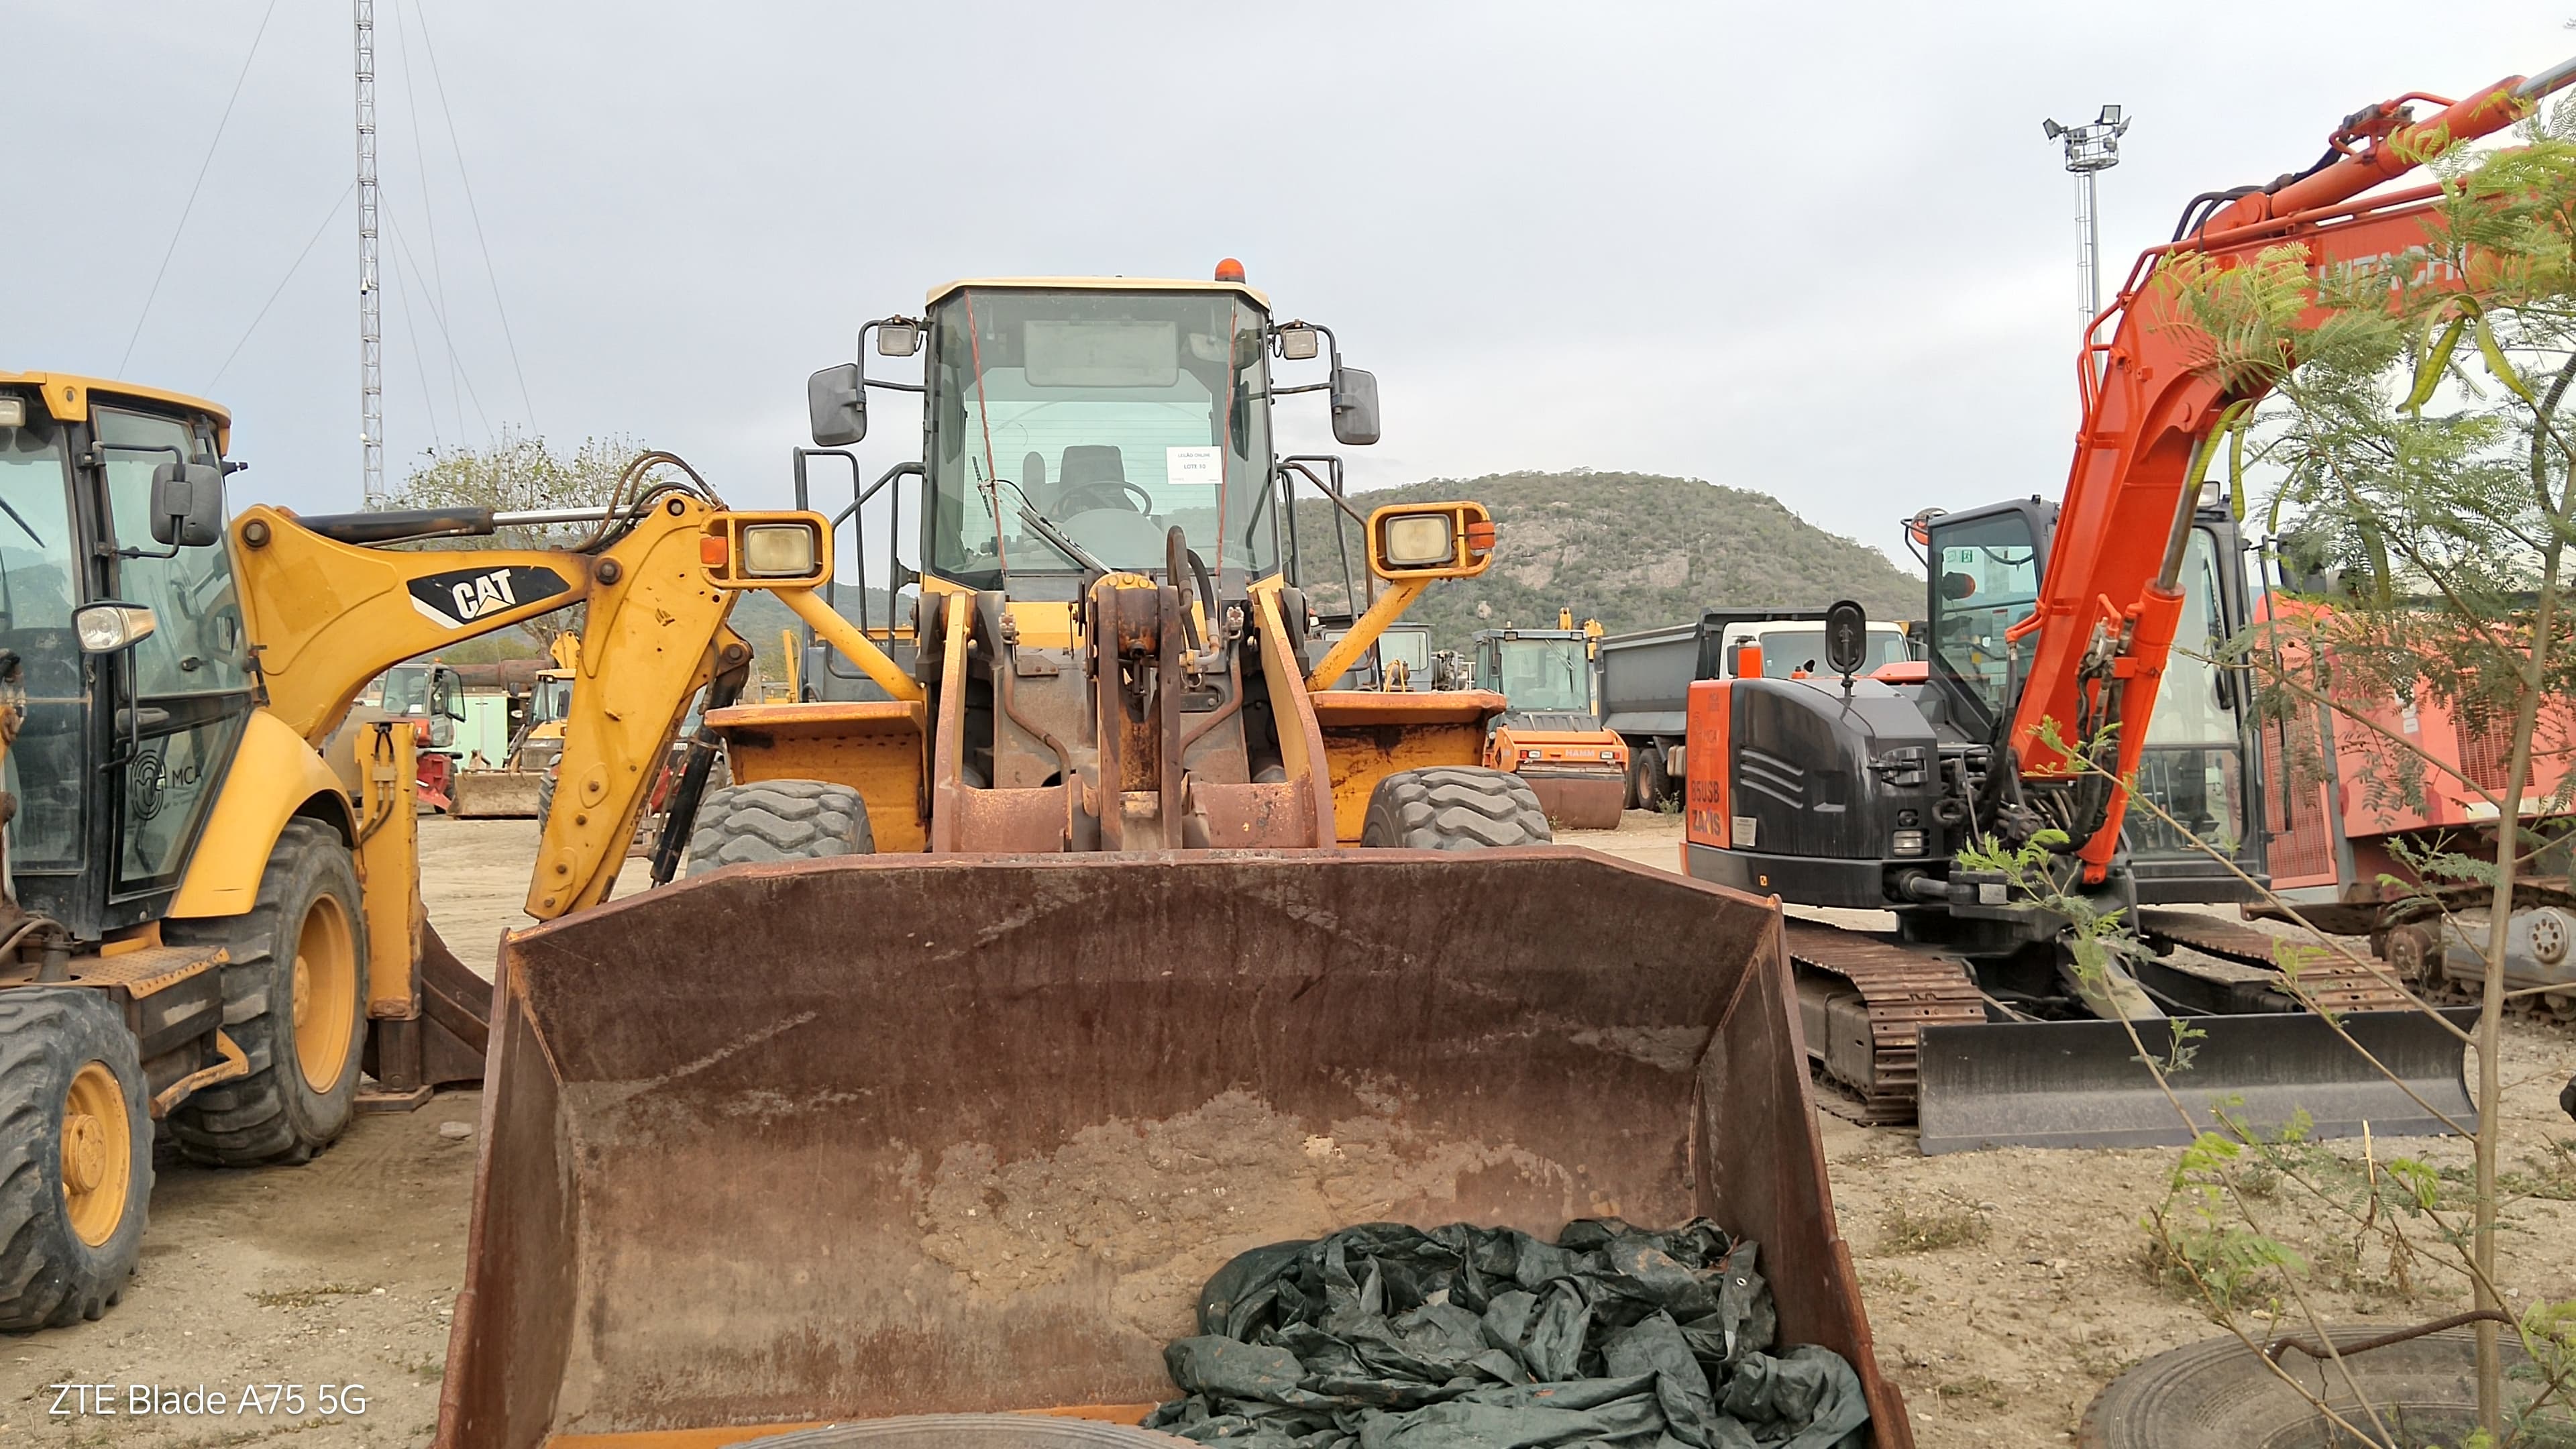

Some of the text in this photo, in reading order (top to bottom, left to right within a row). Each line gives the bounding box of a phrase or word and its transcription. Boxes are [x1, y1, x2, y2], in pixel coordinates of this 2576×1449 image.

[452, 568, 516, 619] CAT
[172, 766, 203, 788] MCA
[1691, 780, 1719, 803] 85USB
[1692, 806, 1721, 837] ZAXIS
